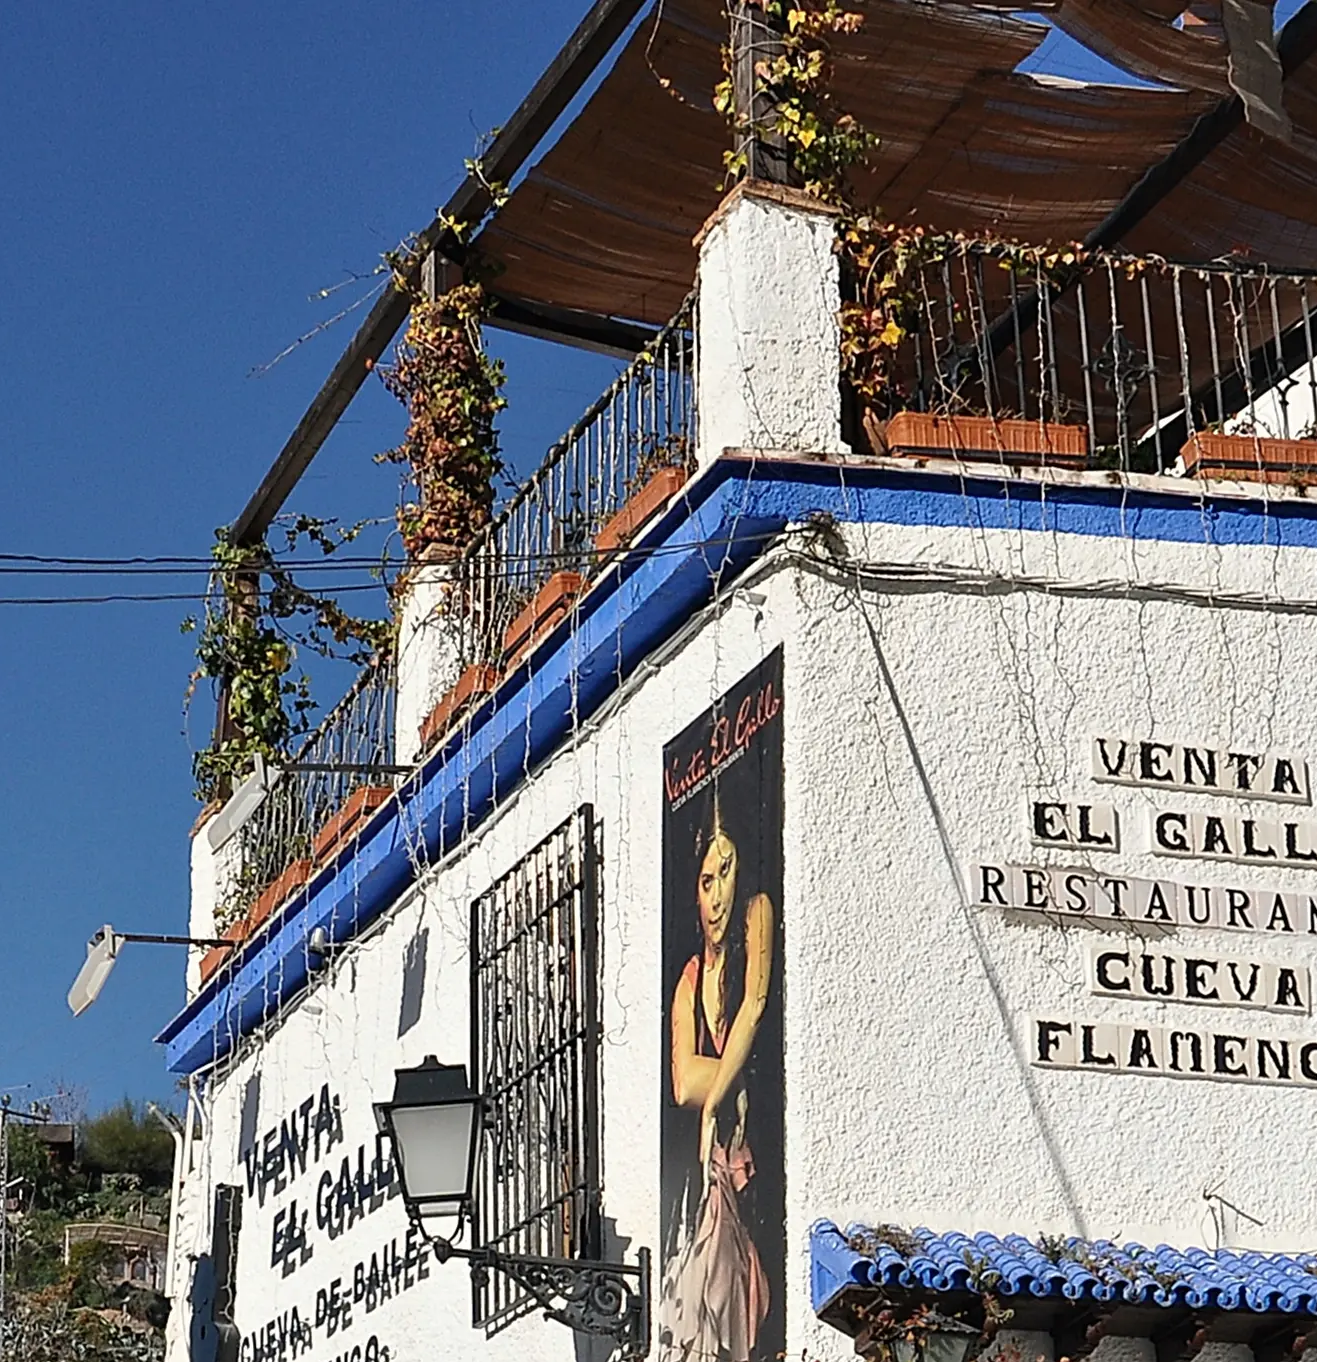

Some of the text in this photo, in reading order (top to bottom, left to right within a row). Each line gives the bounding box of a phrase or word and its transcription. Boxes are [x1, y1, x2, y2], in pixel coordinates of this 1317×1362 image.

[665, 682, 781, 802] Venta El Gallo
[1096, 737, 1303, 794] VENTA
[1033, 801, 1112, 844] EL
[1096, 951, 1304, 1007] CUEVA
[244, 1083, 335, 1199] VENTA
[271, 1133, 395, 1269] EL GALL
